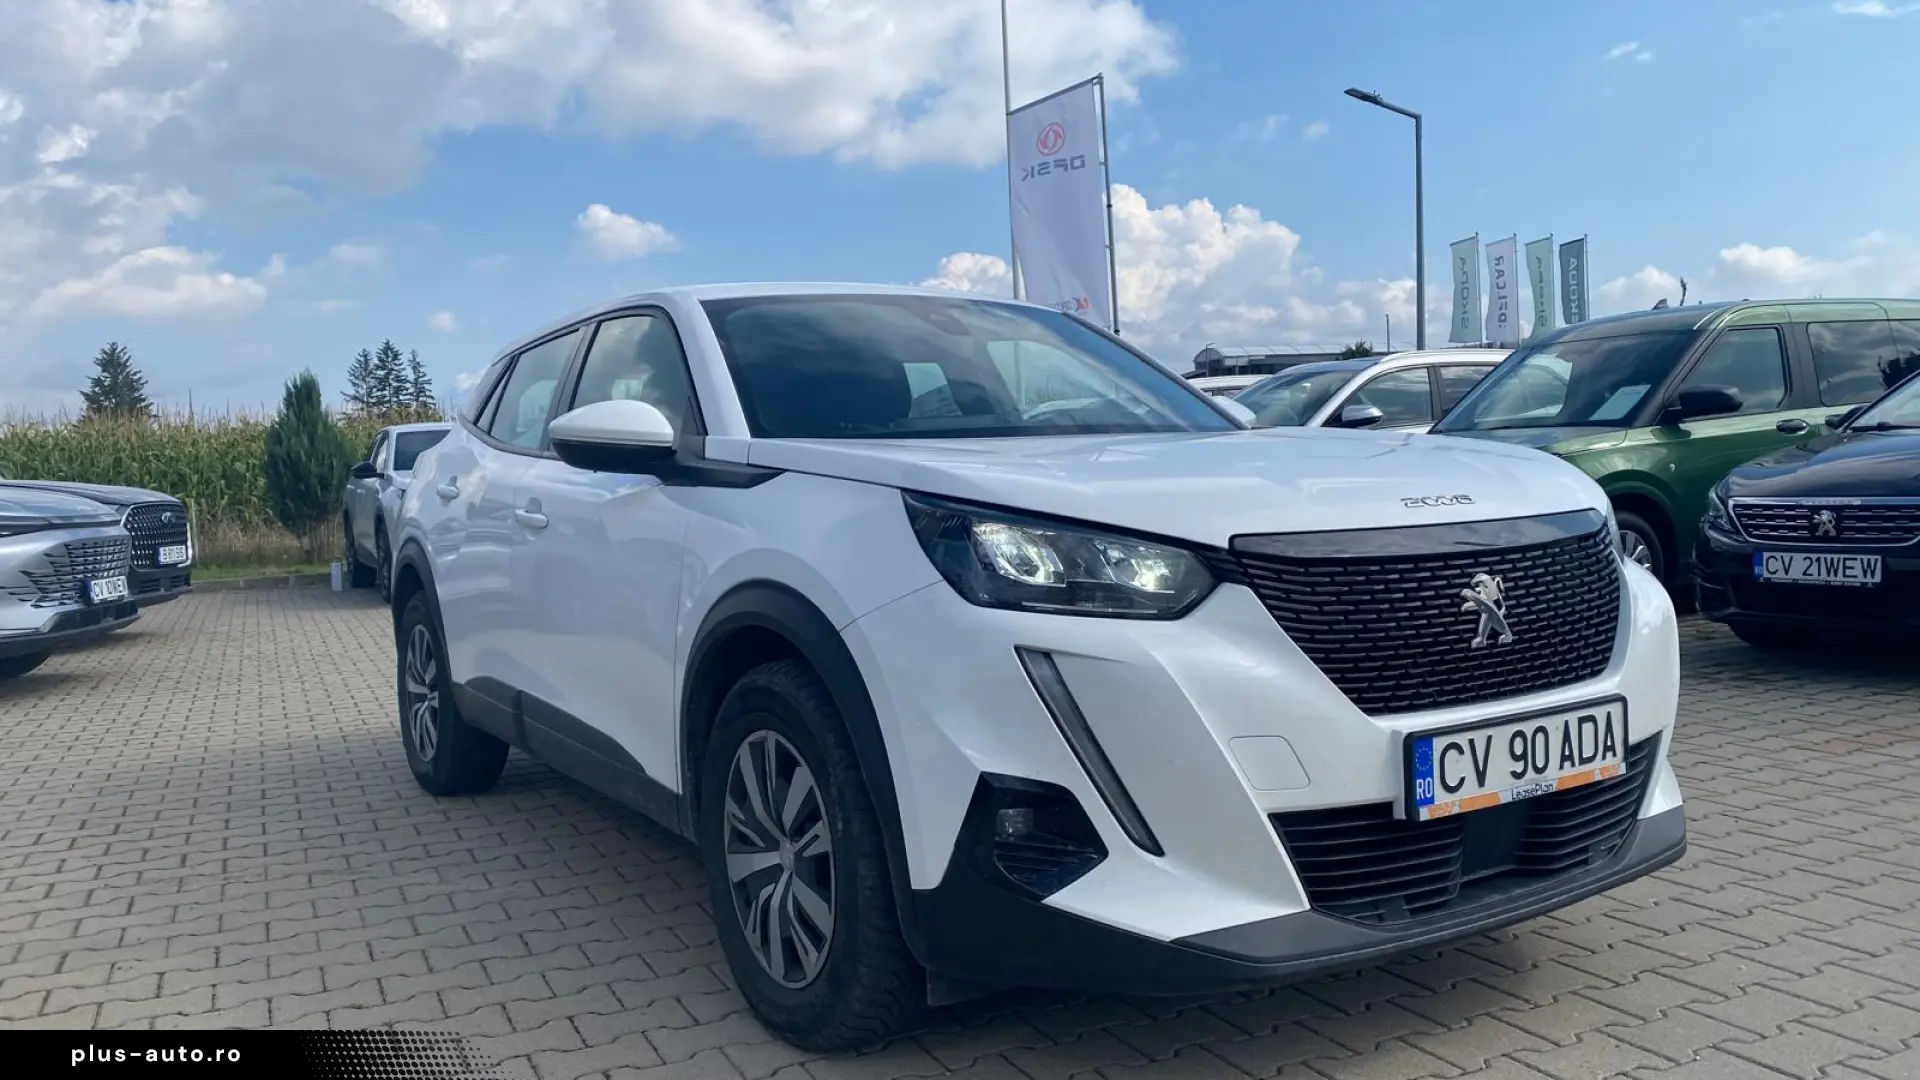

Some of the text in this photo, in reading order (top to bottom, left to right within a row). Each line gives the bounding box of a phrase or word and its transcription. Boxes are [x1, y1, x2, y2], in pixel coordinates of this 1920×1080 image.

[1765, 555, 1879, 580] CV 21WEW
[1439, 710, 1618, 794] CV 90 ADA
[1416, 777, 1434, 800] RO
[1511, 782, 1555, 801] LeasePlan
